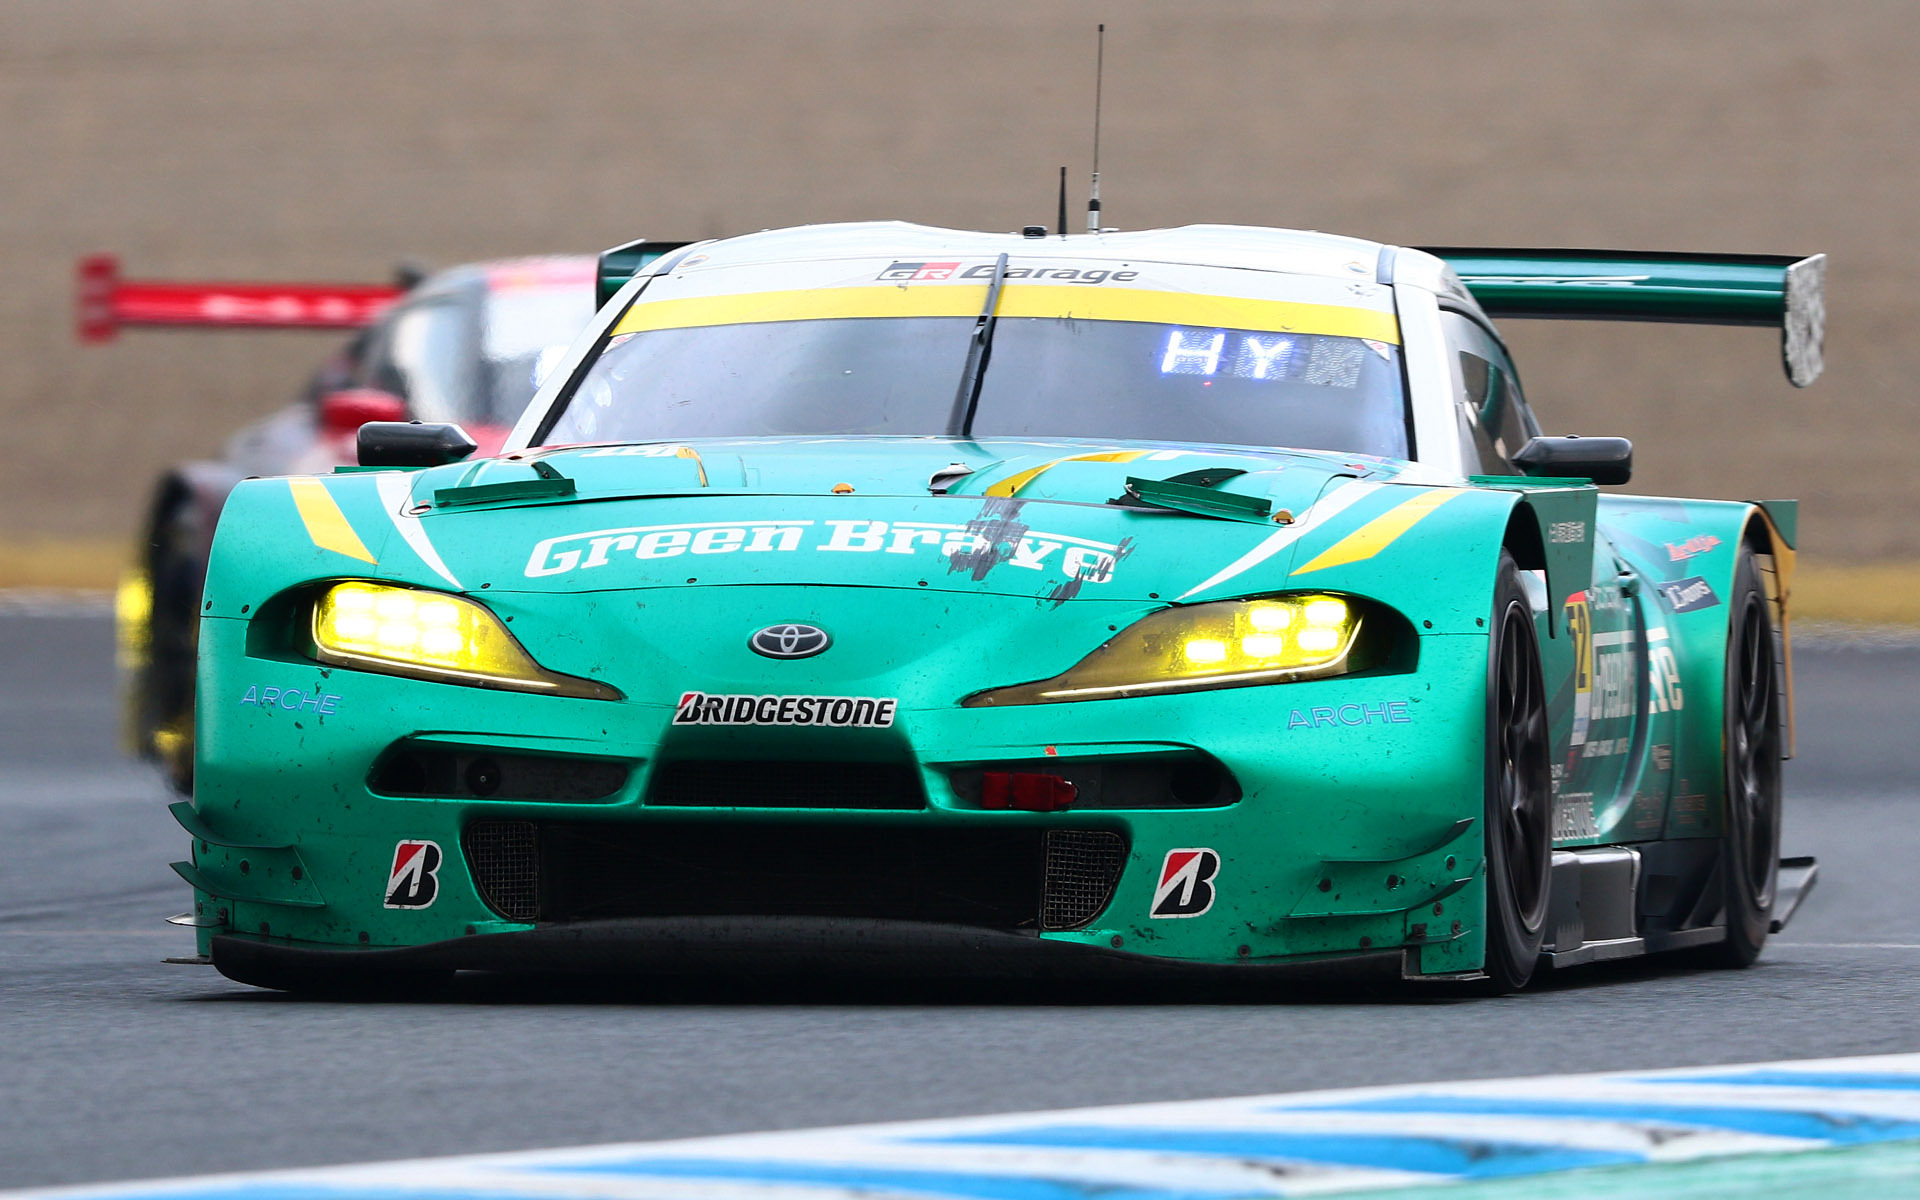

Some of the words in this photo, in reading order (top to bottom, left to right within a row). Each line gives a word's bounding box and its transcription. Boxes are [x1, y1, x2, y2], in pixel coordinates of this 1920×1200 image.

[878, 265, 957, 281] GR
[960, 265, 1139, 284] Garage
[1161, 330, 1291, 379] HY
[524, 520, 815, 578] Green
[817, 520, 1126, 583] Brave
[240, 685, 342, 716] ARCHE
[674, 694, 895, 726] BRIDGESTONE
[1287, 701, 1411, 730] ARCHE
